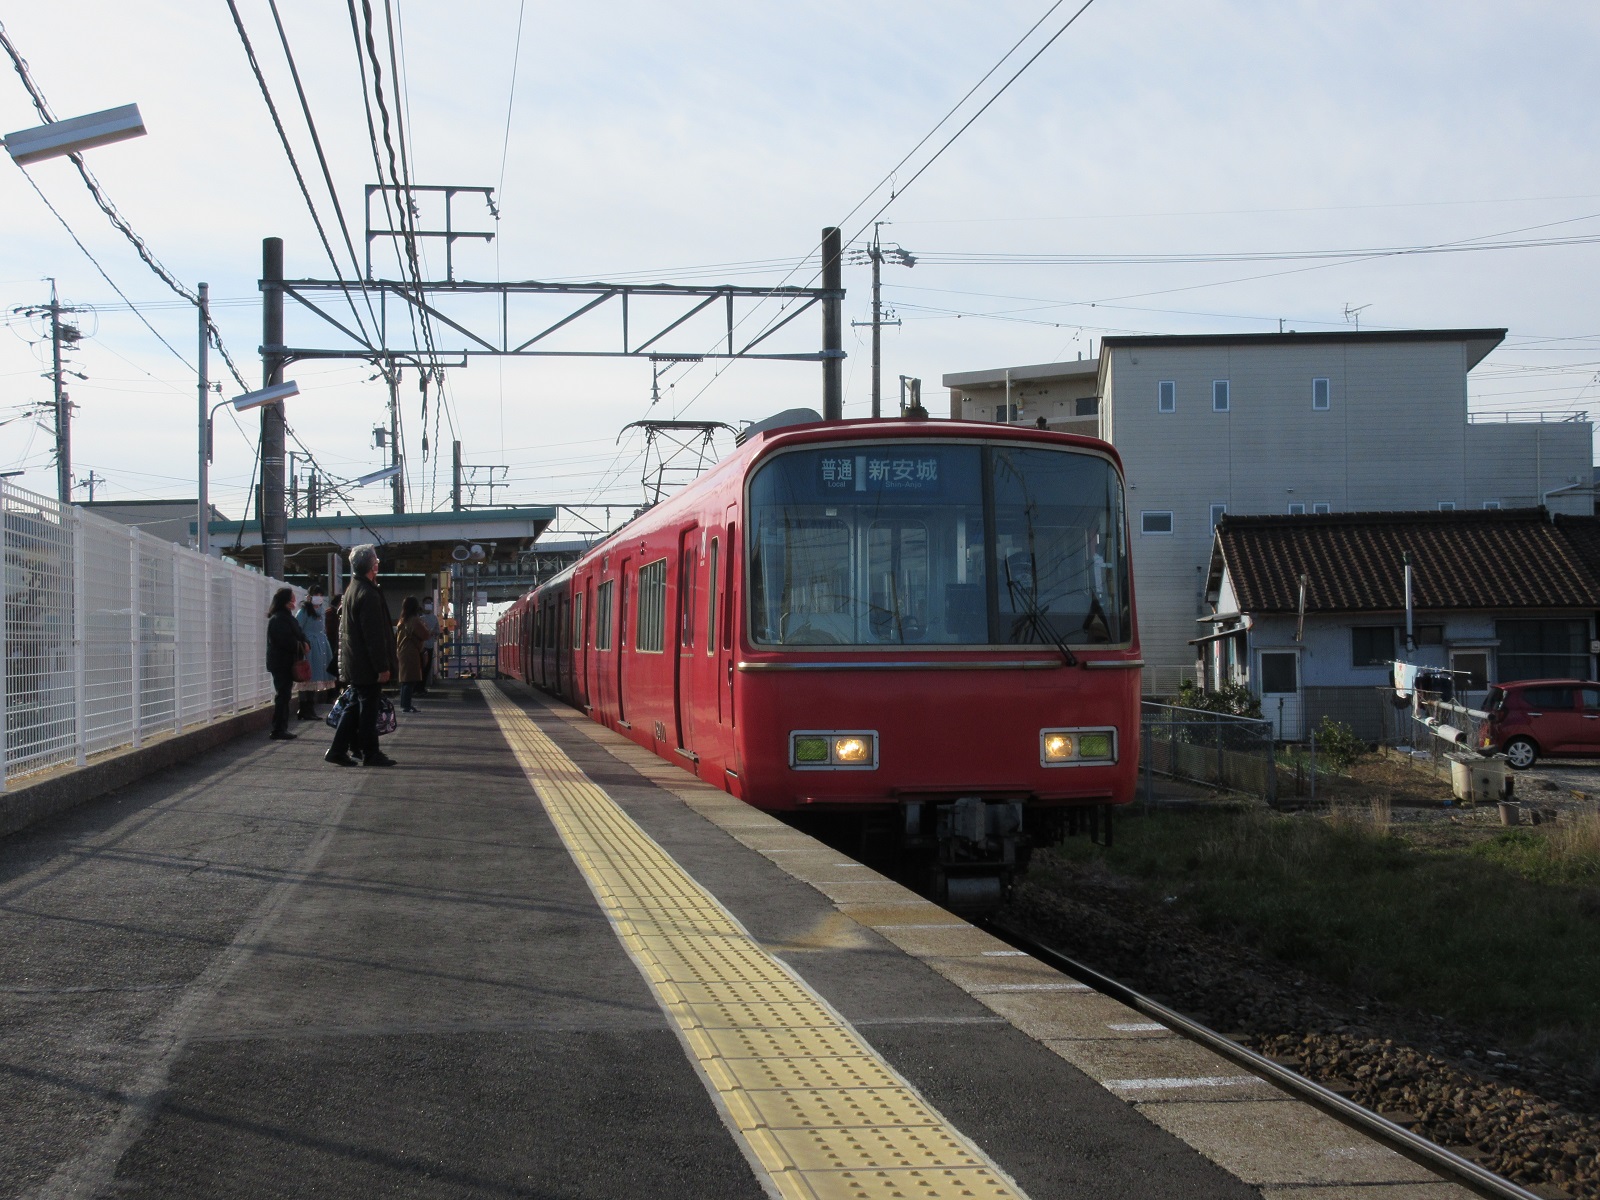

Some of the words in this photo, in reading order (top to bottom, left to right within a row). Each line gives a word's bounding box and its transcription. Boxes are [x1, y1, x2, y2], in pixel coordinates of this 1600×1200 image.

[822, 459, 853, 481] 普通
[869, 458, 938, 481] 新安城
